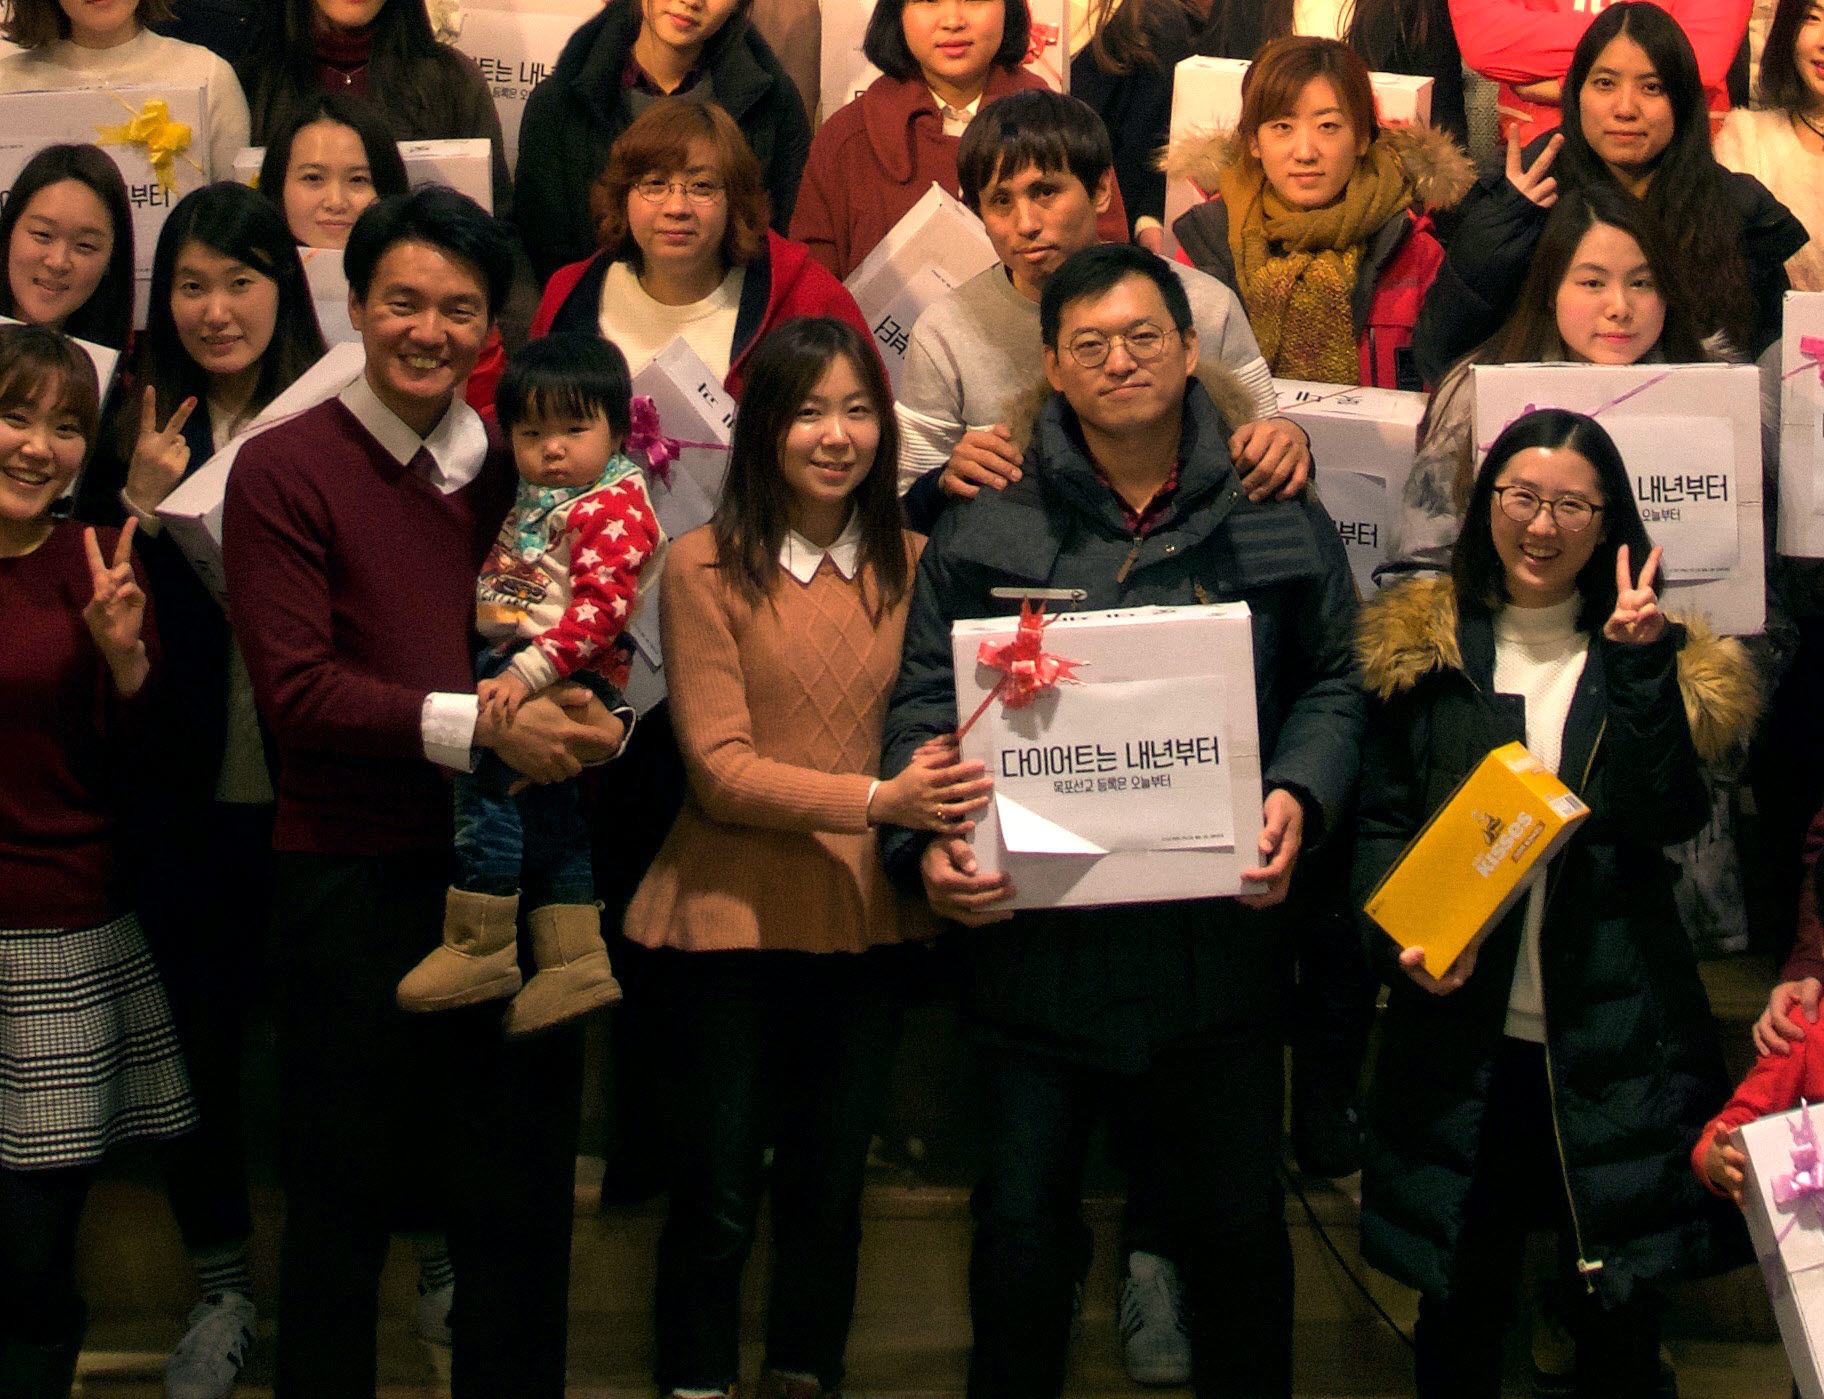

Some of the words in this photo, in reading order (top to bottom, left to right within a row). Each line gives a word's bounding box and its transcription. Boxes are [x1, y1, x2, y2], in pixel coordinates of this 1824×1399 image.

[1638, 474, 1728, 503] 내년부터
[1642, 508, 1680, 521] 오늘부터
[1002, 744, 1117, 778] 다이어트는
[1126, 736, 1220, 770] 내년부터
[1054, 777, 1093, 794] 목포선교
[1098, 777, 1126, 790] 등록은
[1131, 775, 1171, 789] 오늘부터
